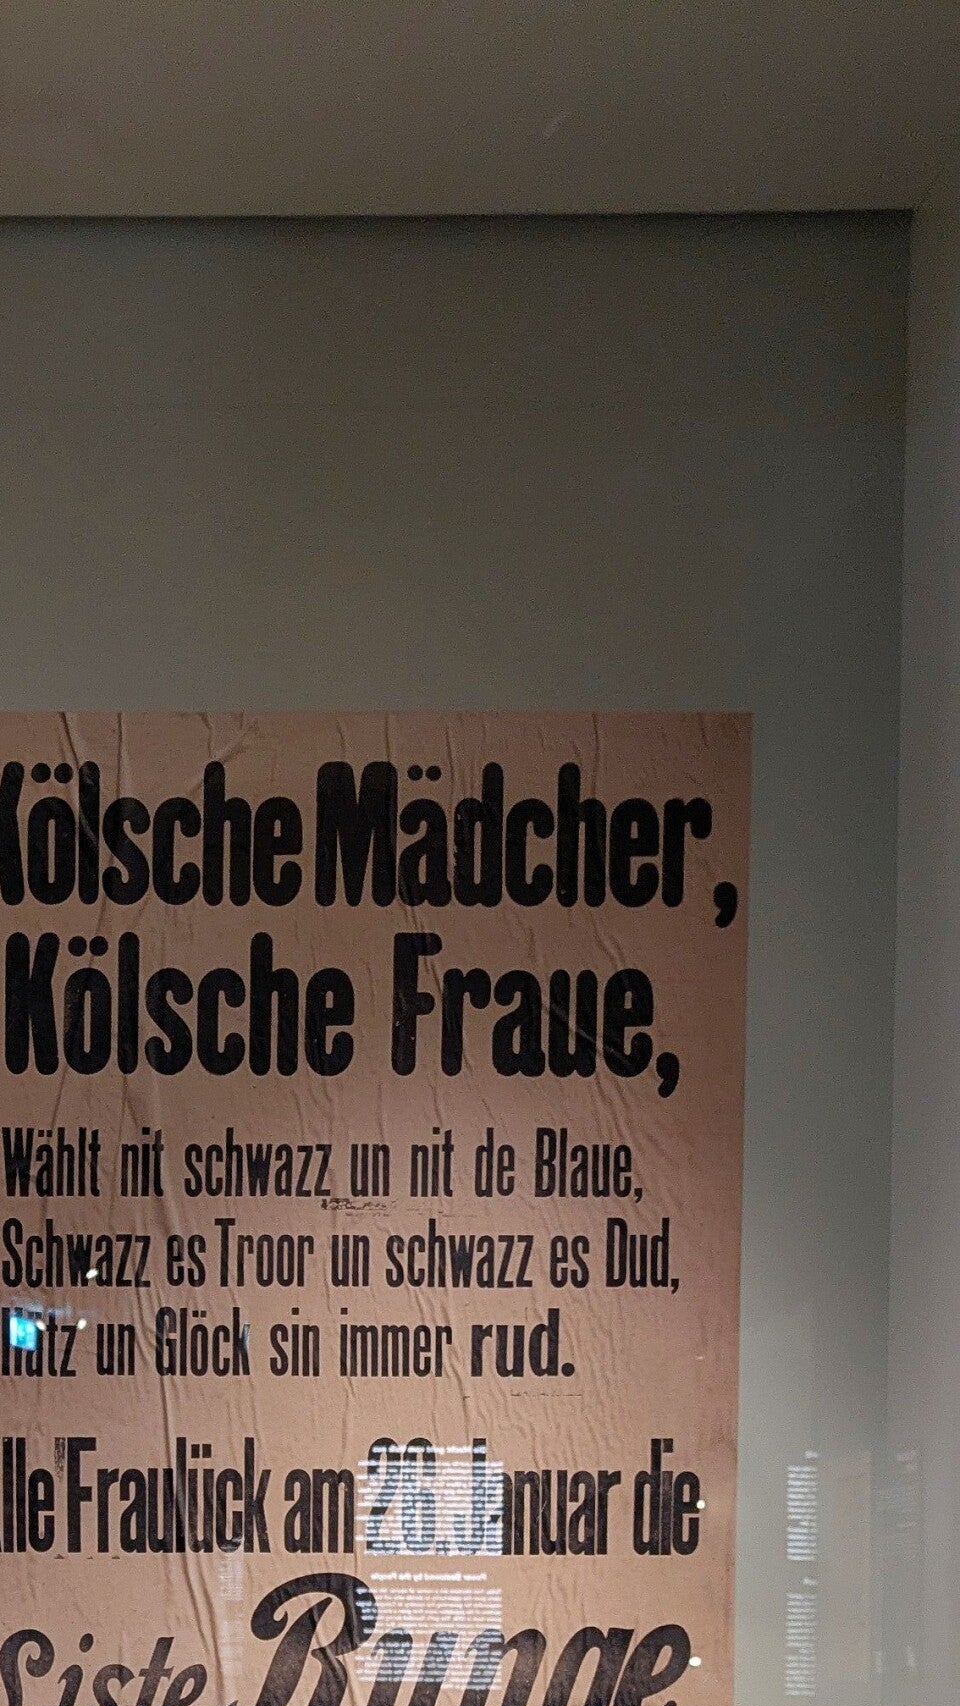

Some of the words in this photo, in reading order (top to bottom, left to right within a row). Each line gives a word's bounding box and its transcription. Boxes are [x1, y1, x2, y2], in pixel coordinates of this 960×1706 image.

[315, 761, 739, 929] Mädcher,
[5, 932, 355, 1076] Kölsche
[391, 932, 680, 1098] Fraue,
[2, 1127, 101, 1197] Wählt
[120, 1126, 164, 1197] nit
[184, 1127, 332, 1197] schwazz
[351, 1144, 389, 1197] un
[411, 1130, 454, 1197] nit
[475, 1127, 514, 1197] de
[535, 1128, 642, 1203] Blaue,
[2, 1218, 151, 1288] Schwazz
[167, 1235, 206, 1287] es
[215, 1218, 314, 1287] Troor
[332, 1235, 369, 1286] un
[386, 1219, 533, 1288] schwazz
[550, 1236, 589, 1288] es
[606, 1217, 679, 1294] Dud,
[97, 1324, 135, 1375] un
[156, 1307, 250, 1376] Glöck
[270, 1307, 319, 1376] sin
[341, 1307, 452, 1376] immer
[472, 1308, 574, 1377] rud.
[67, 1437, 271, 1553] Fraulück
[285, 1469, 354, 1553] am
[634, 1439, 700, 1555] die
